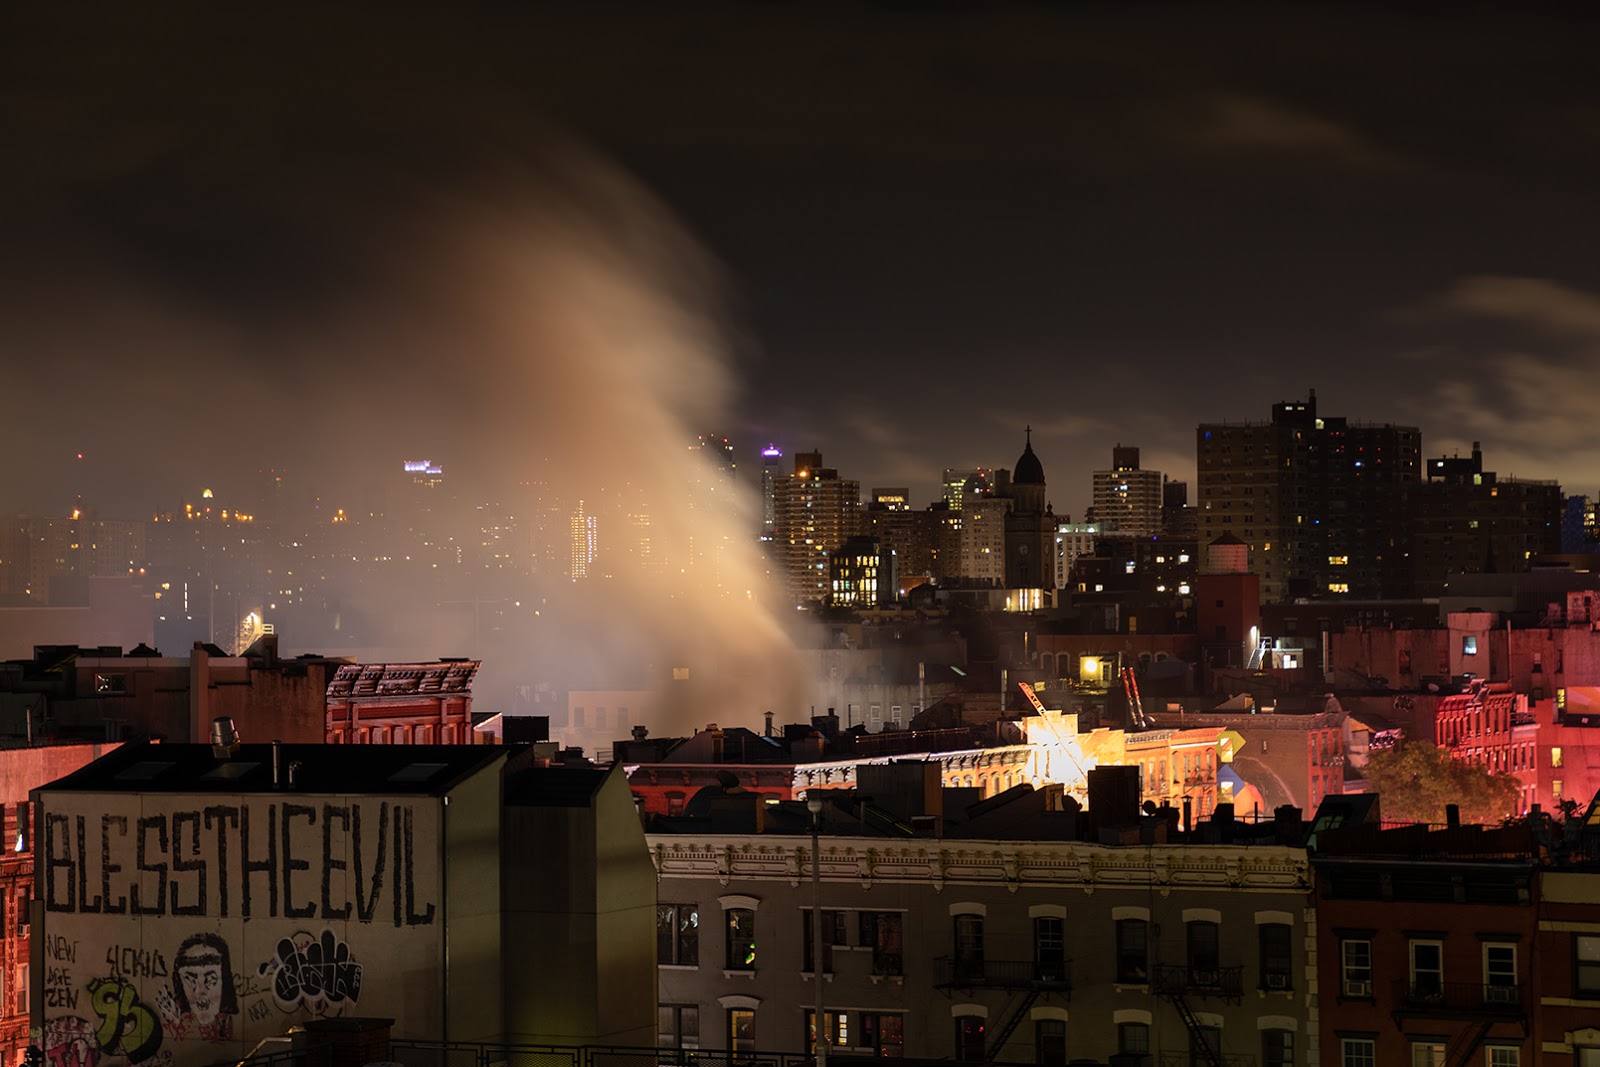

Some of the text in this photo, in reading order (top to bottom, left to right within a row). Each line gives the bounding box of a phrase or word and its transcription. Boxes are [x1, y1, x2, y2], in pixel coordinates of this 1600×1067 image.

[47, 934, 80, 964] NEW
[47, 966, 72, 986] AGE
[45, 987, 79, 1010] ZEN
